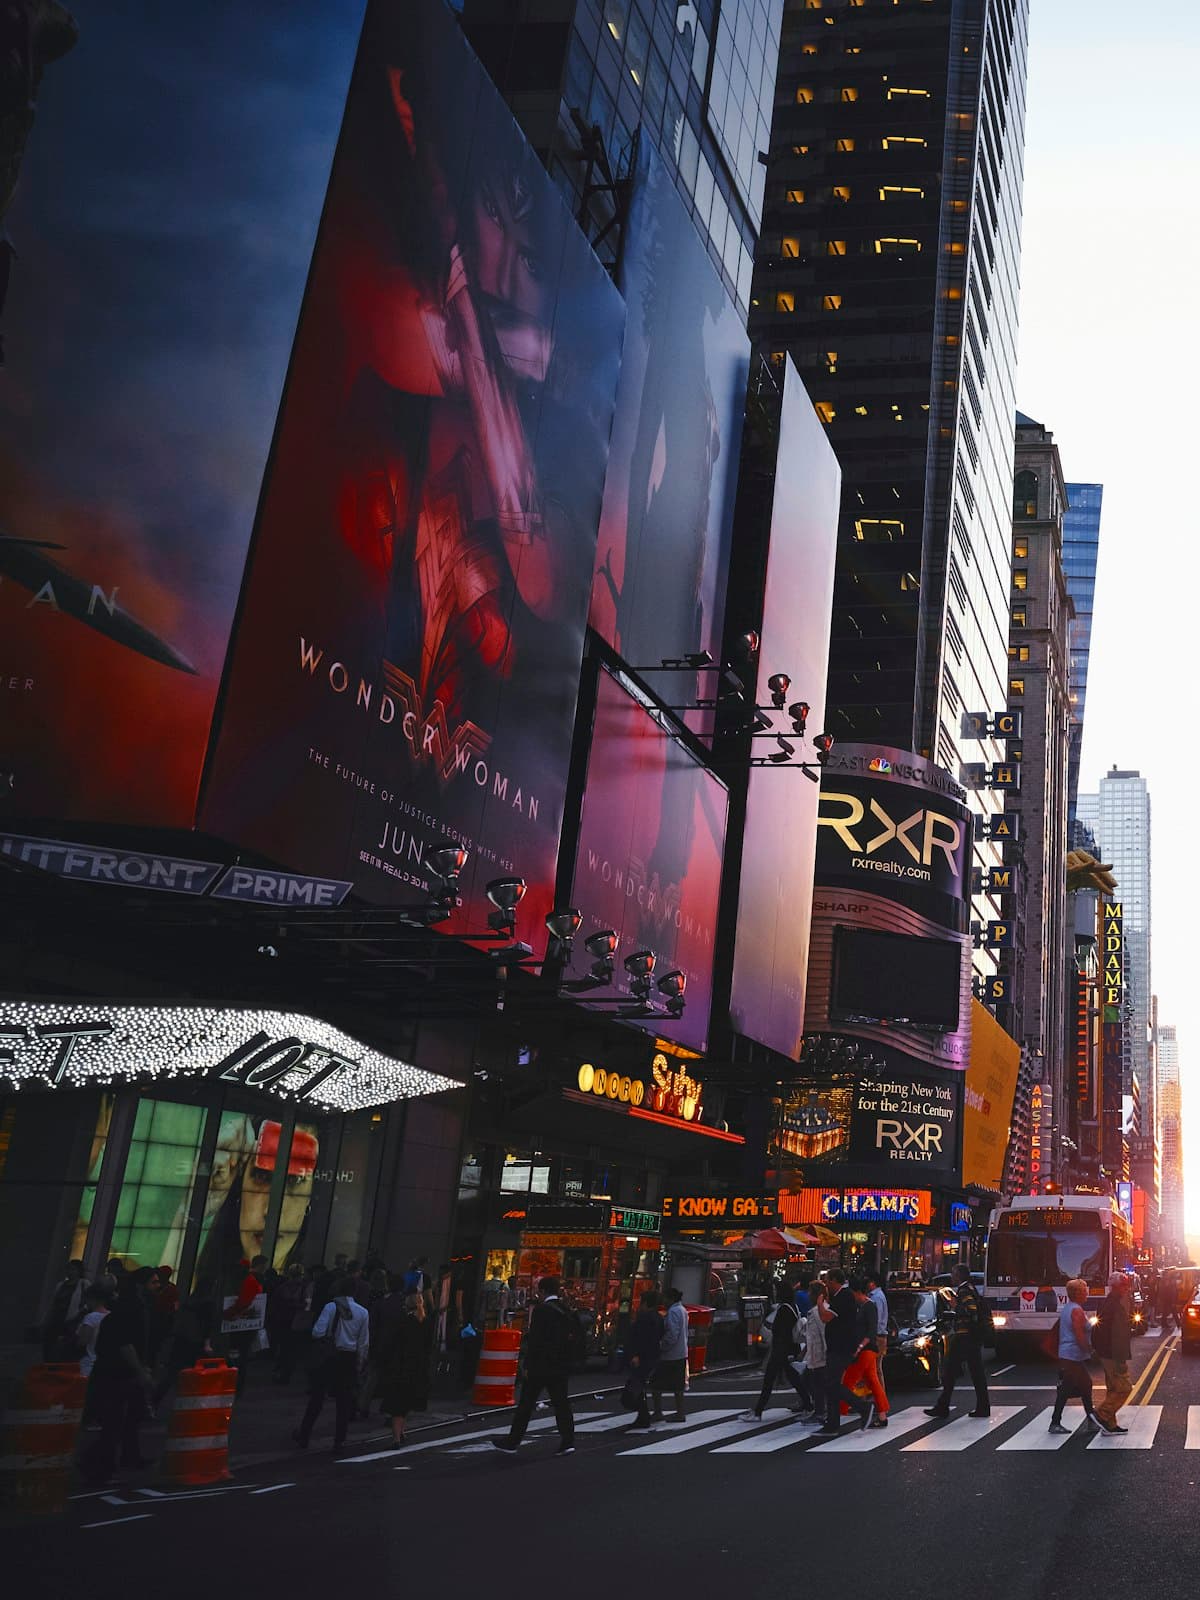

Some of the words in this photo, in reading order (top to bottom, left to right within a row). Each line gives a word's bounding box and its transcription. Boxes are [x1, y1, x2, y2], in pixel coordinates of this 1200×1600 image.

[0, 575, 120, 617] AN
[300, 637, 440, 755] WONDER
[454, 742, 539, 821] WOMAN
[309, 748, 329, 769] THE
[335, 763, 376, 795] FUTURE
[381, 789, 394, 803] OF
[399, 800, 437, 829] JUSTICE
[440, 823, 472, 849] BEGINS
[476, 844, 497, 861] WITH
[500, 856, 514, 873] HER
[378, 821, 432, 865] JUN
[817, 792, 961, 878] RXR
[0, 839, 207, 890] TFRONT
[851, 856, 931, 881] rxrrealty.com
[230, 871, 337, 906] PRIME
[588, 849, 657, 913] WONDER
[663, 902, 710, 945] WOMAN
[813, 901, 870, 913] SHARP
[1103, 901, 1122, 1003] MADAME
[217, 1030, 358, 1100] LOFT
[858, 1077, 910, 1099] Shaping
[911, 1081, 934, 1098] New
[935, 1086, 953, 1101] York
[858, 1096, 877, 1110] for
[880, 1097, 899, 1112] the
[901, 1101, 921, 1114] 21st
[922, 1102, 954, 1122] Century
[875, 1118, 943, 1153] RXR
[889, 1149, 933, 1161] REALTY
[623, 1211, 655, 1231] WATER
[679, 1197, 728, 1217] KNOW
[733, 1196, 776, 1217] GAE
[822, 1194, 920, 1219] CHAMPS
